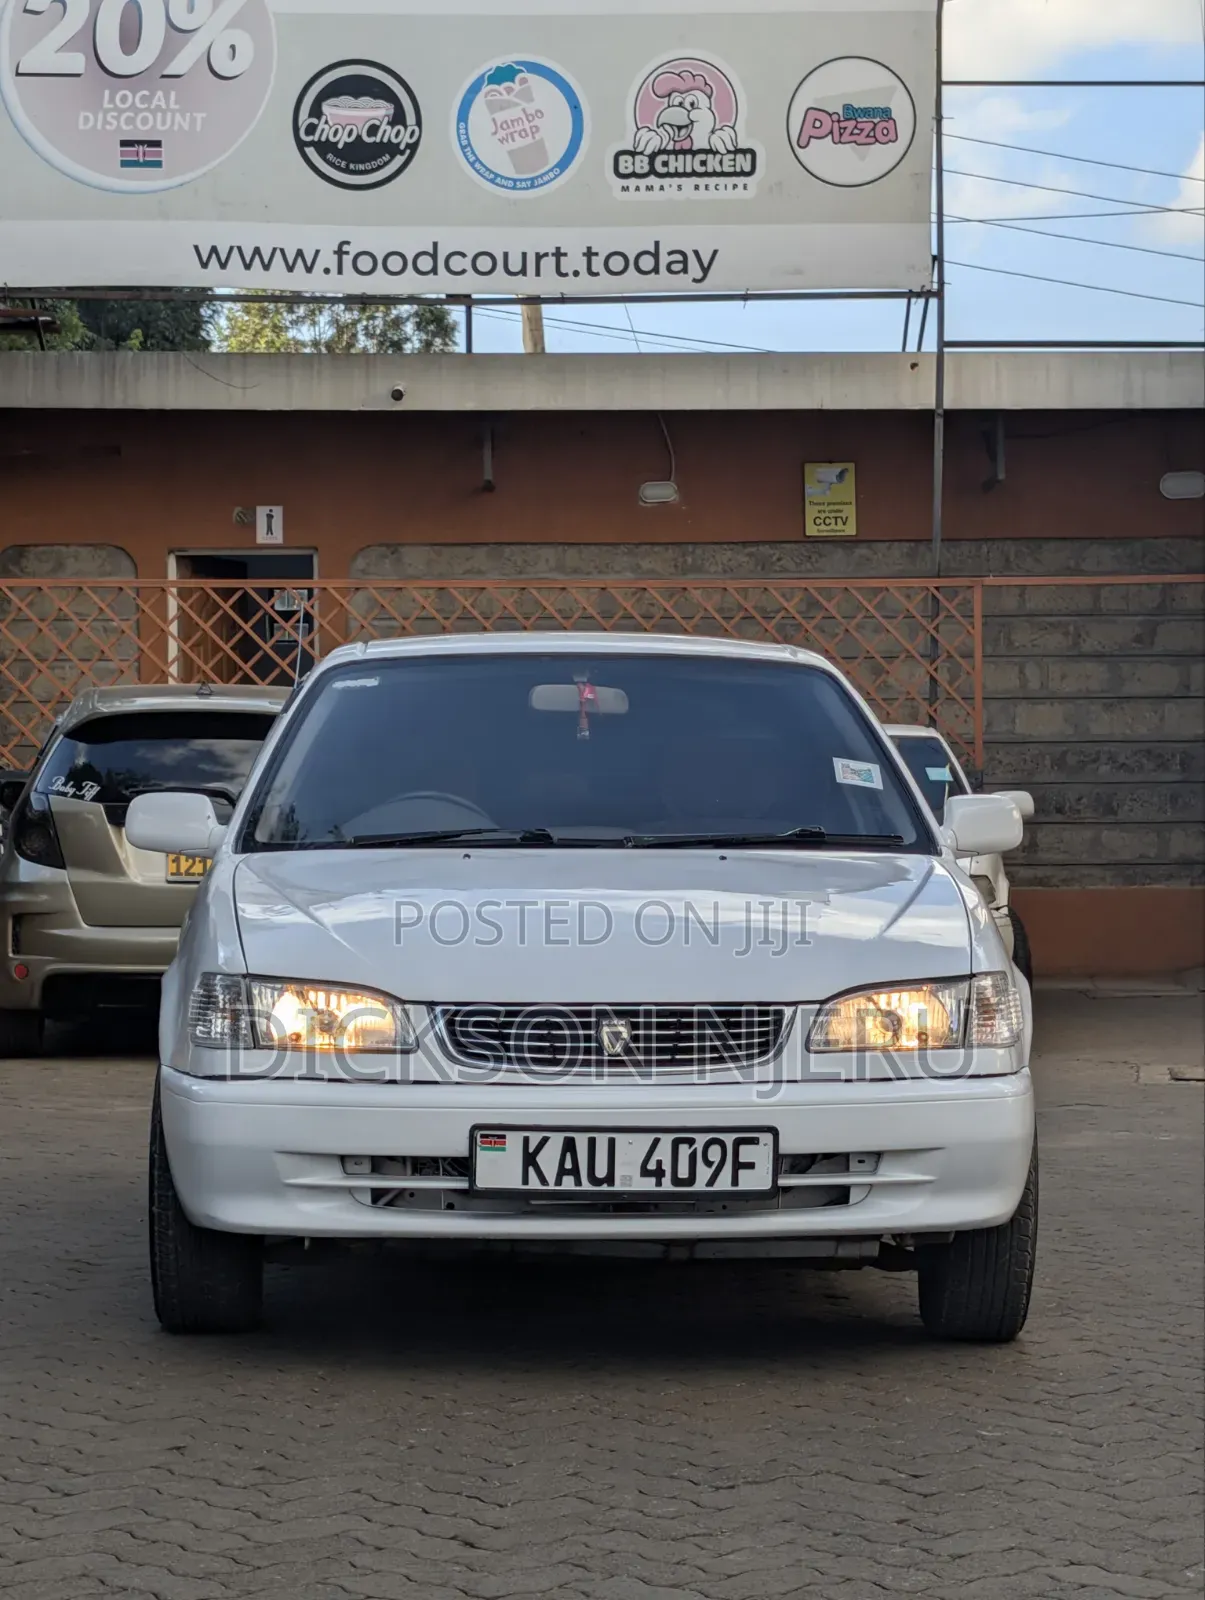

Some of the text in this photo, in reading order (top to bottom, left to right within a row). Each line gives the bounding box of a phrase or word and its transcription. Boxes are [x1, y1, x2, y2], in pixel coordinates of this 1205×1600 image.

[15, 0, 254, 80] 20%
[103, 89, 180, 109] LOCAL
[78, 111, 207, 132] DISCOUNT
[491, 107, 545, 136] Jambo
[842, 104, 892, 120] Bwana
[300, 114, 420, 150] Chop Chop
[497, 124, 540, 145] wrap
[797, 107, 898, 149] Pizza
[326, 153, 391, 171] RICE KINGDOM
[458, 122, 560, 189] GRAB THE WRAP AND SAY JAMBO
[618, 153, 752, 174] BB CHICKEN
[621, 183, 748, 192] MAMA'S RECIPE
[193, 240, 719, 284] www.foodcourt.today
[813, 516, 848, 526] CCTV
[48, 776, 76, 797] Baby
[521, 1135, 616, 1187] KAU
[639, 1136, 760, 1187] 409F
